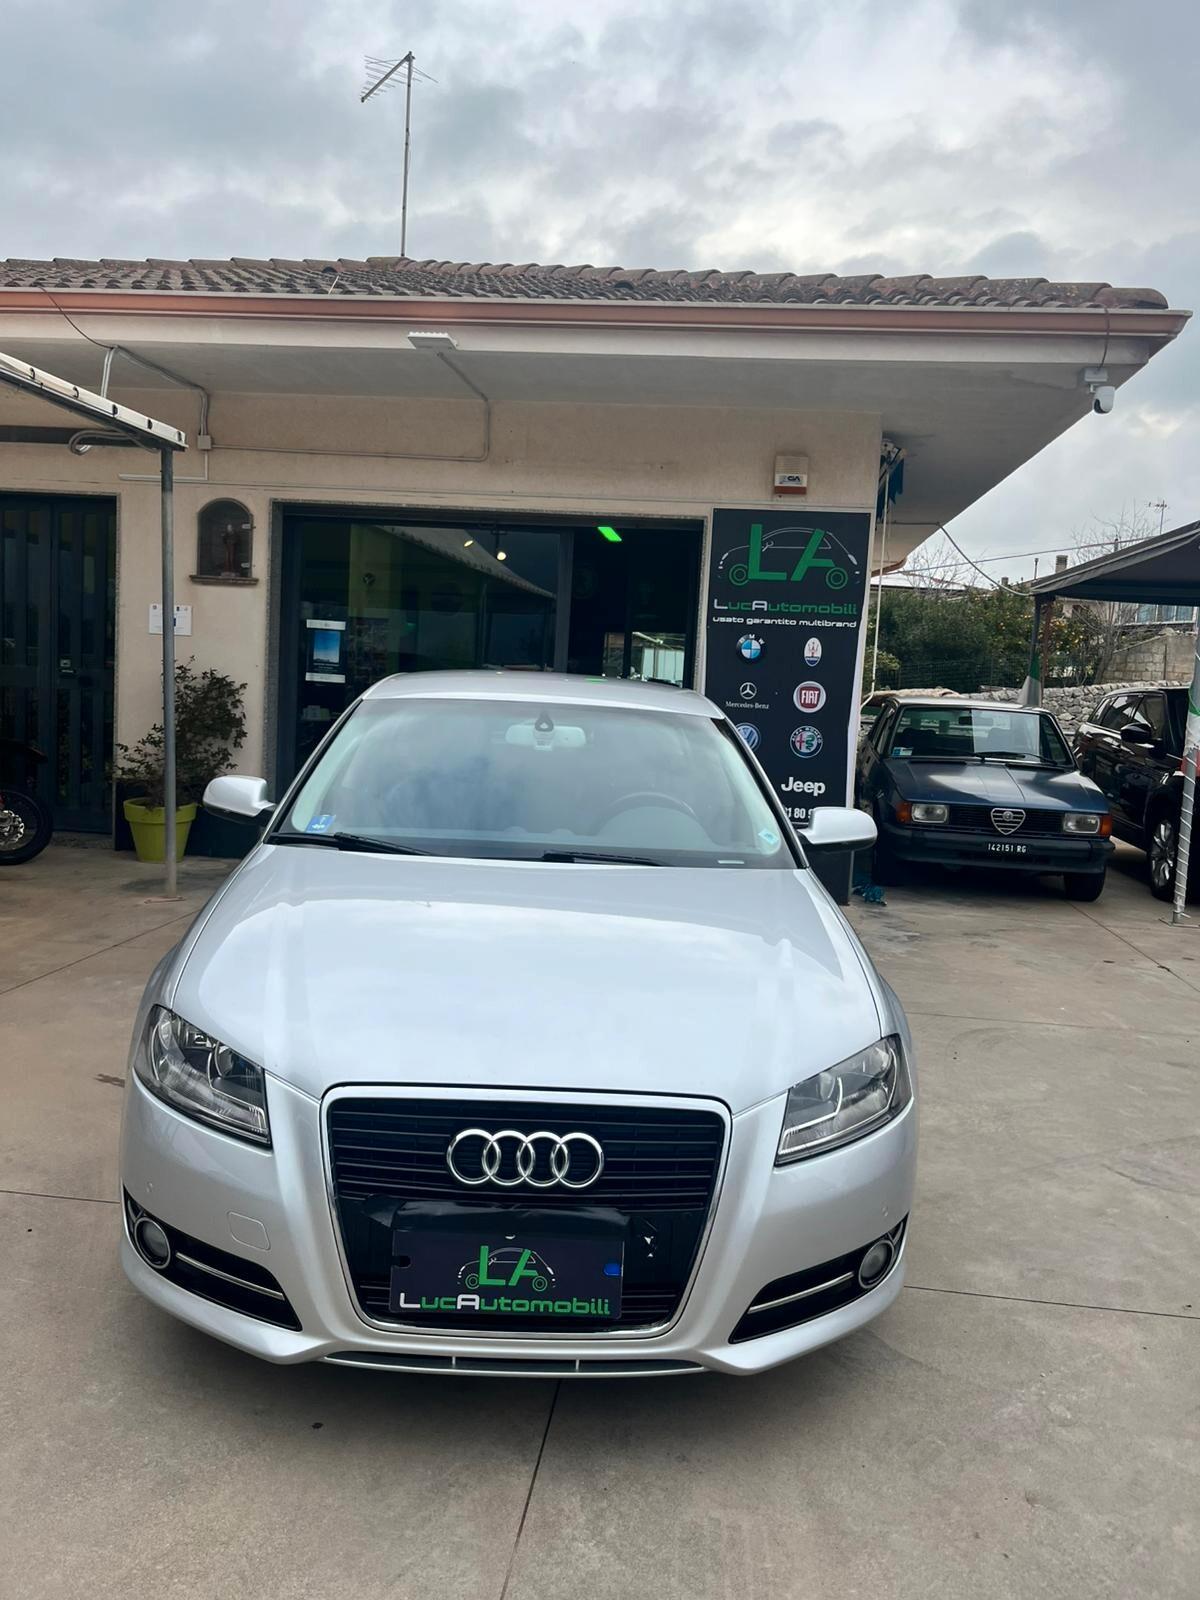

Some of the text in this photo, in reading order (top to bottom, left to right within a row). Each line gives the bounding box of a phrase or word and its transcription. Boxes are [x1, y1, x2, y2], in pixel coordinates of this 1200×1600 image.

[714, 598, 858, 615] LucAutomobili
[712, 616, 857, 628] usato garantito multibrand
[801, 690, 820, 704] FIAT
[725, 701, 770, 710] Mercedes-Benz
[780, 776, 826, 797] Jeep
[794, 807, 806, 819] 80
[987, 843, 1027, 853] 142151 RG
[399, 1293, 610, 1315] LucAutomobili
